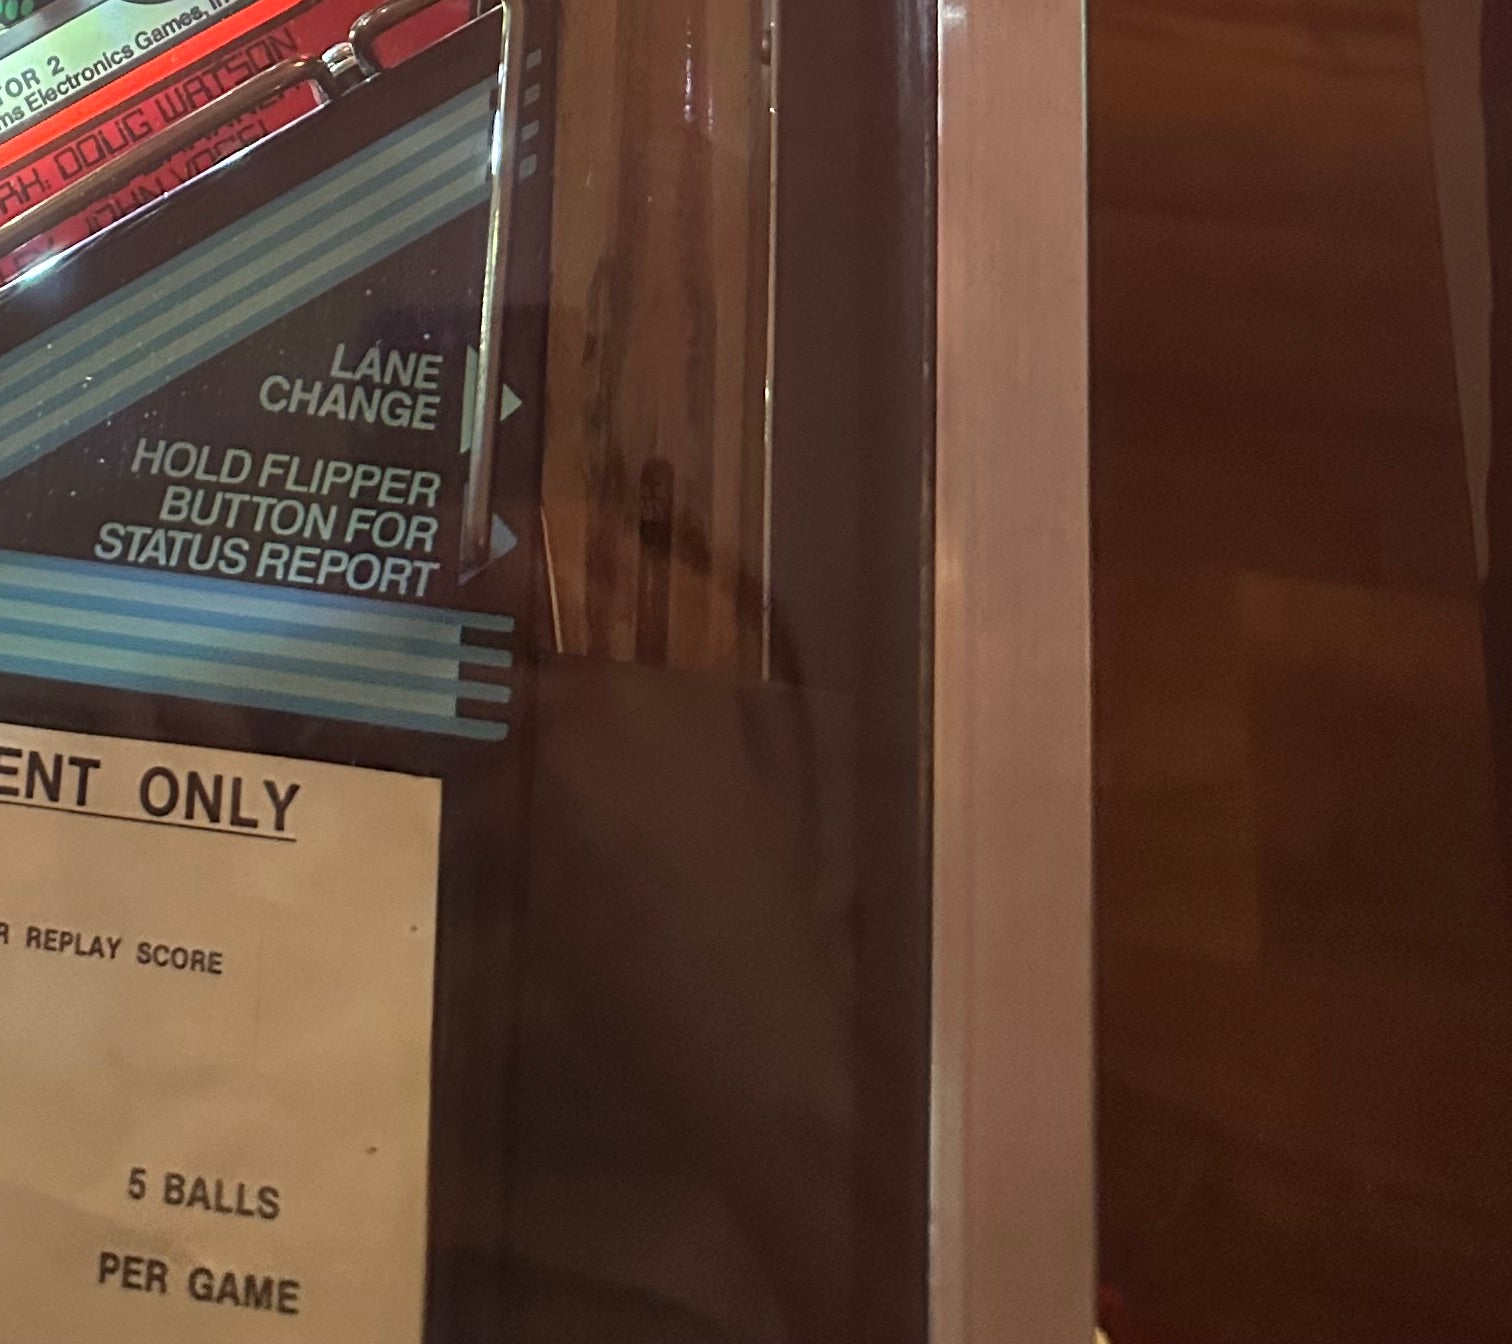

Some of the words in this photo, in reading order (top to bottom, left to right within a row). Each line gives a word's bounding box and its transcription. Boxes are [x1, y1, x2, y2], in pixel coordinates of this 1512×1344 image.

[24, 39, 135, 110] Electronics
[134, 5, 210, 50] Games,
[47, 54, 66, 79] 2
[54, 115, 152, 183] DOUG
[155, 26, 300, 124] WATSON
[330, 343, 444, 390] LANE
[258, 374, 442, 432] CHANGE
[130, 438, 254, 483] HOLD
[255, 452, 442, 508] FLIPPER
[160, 488, 337, 543] BUTTON
[343, 506, 440, 554] FOR
[93, 523, 256, 577] STATUS
[257, 540, 440, 599] REPORT
[137, 765, 303, 834] ONLY
[24, 924, 123, 963] REPLAY
[135, 940, 225, 977] SCORE
[126, 1169, 149, 1203] 5
[162, 1174, 281, 1221] BALLS
[96, 1251, 169, 1297] PER
[187, 1266, 302, 1317] GAME
